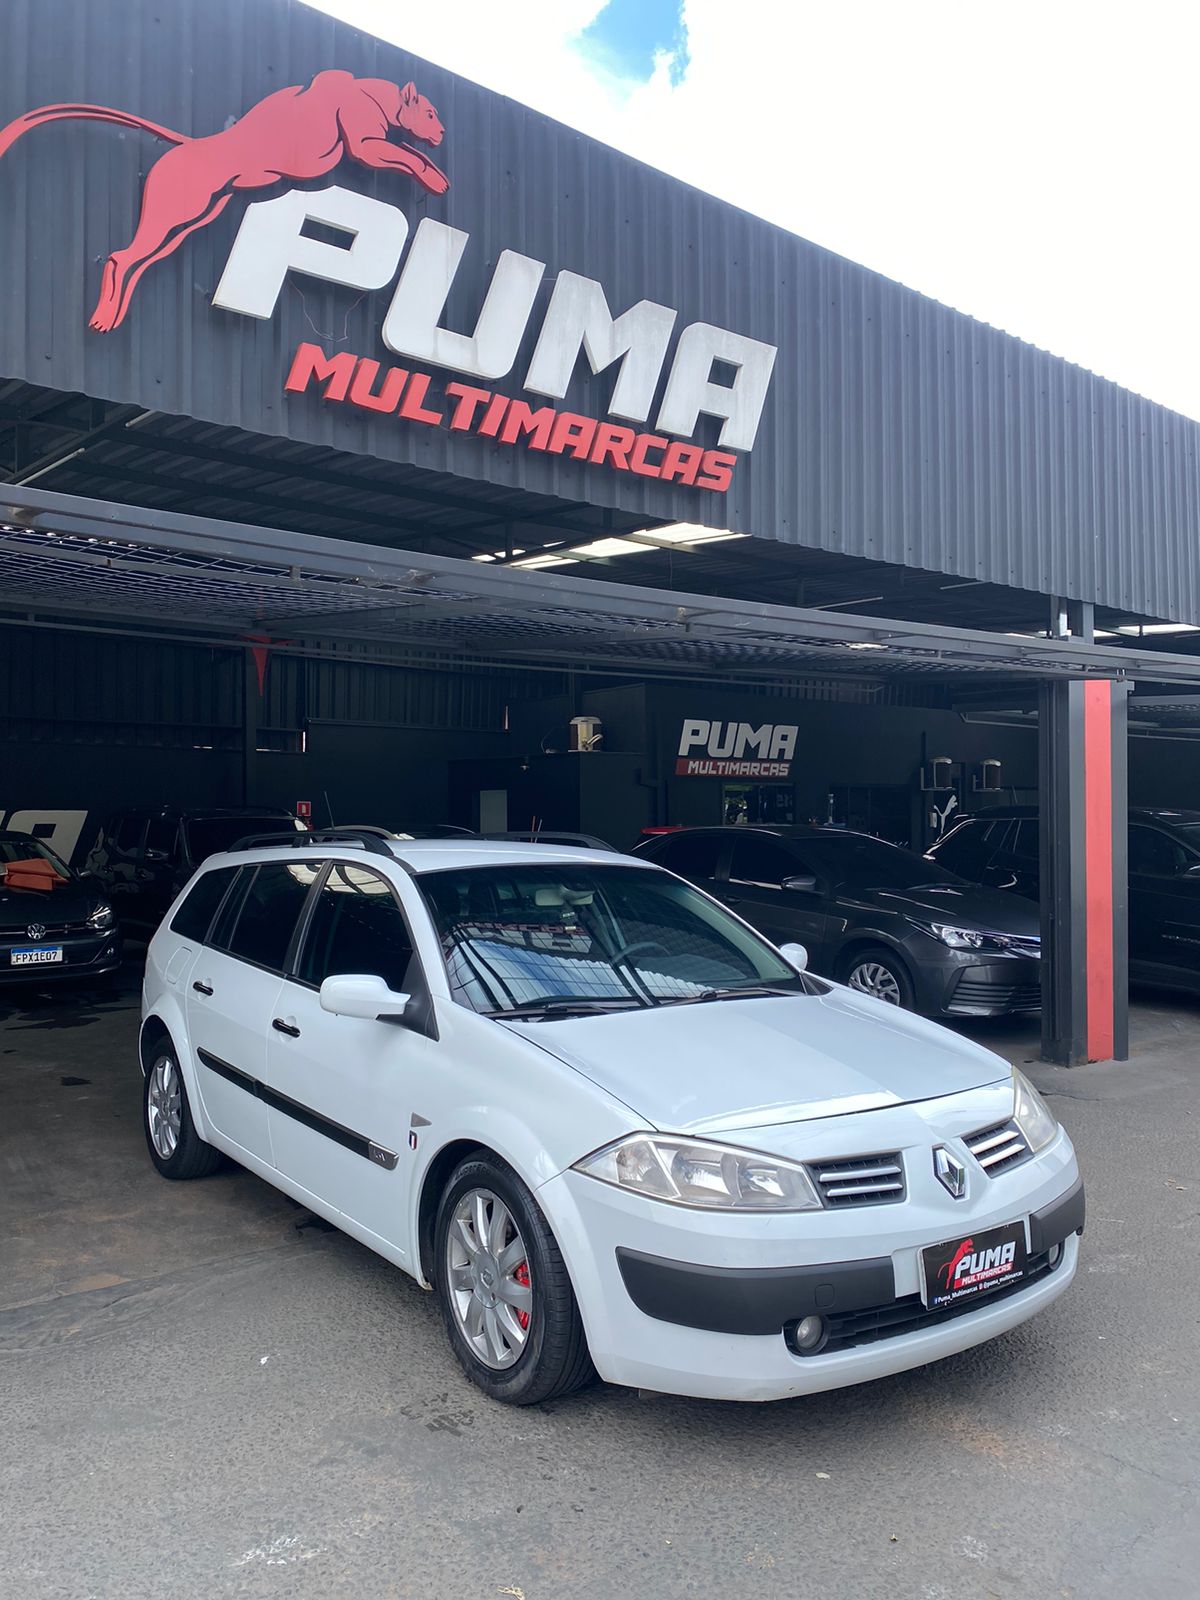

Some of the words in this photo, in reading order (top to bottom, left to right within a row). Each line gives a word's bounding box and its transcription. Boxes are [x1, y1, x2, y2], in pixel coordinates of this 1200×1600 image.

[212, 185, 778, 452] PUMA
[285, 342, 738, 493] MULTIMARCAS
[678, 719, 799, 760] PUMA
[687, 760, 790, 776] MULTIMARCAS
[15, 951, 58, 963] FPX1E07
[954, 1240, 1016, 1280] PUMA
[961, 1262, 1013, 1287] MULTIMARCAS
